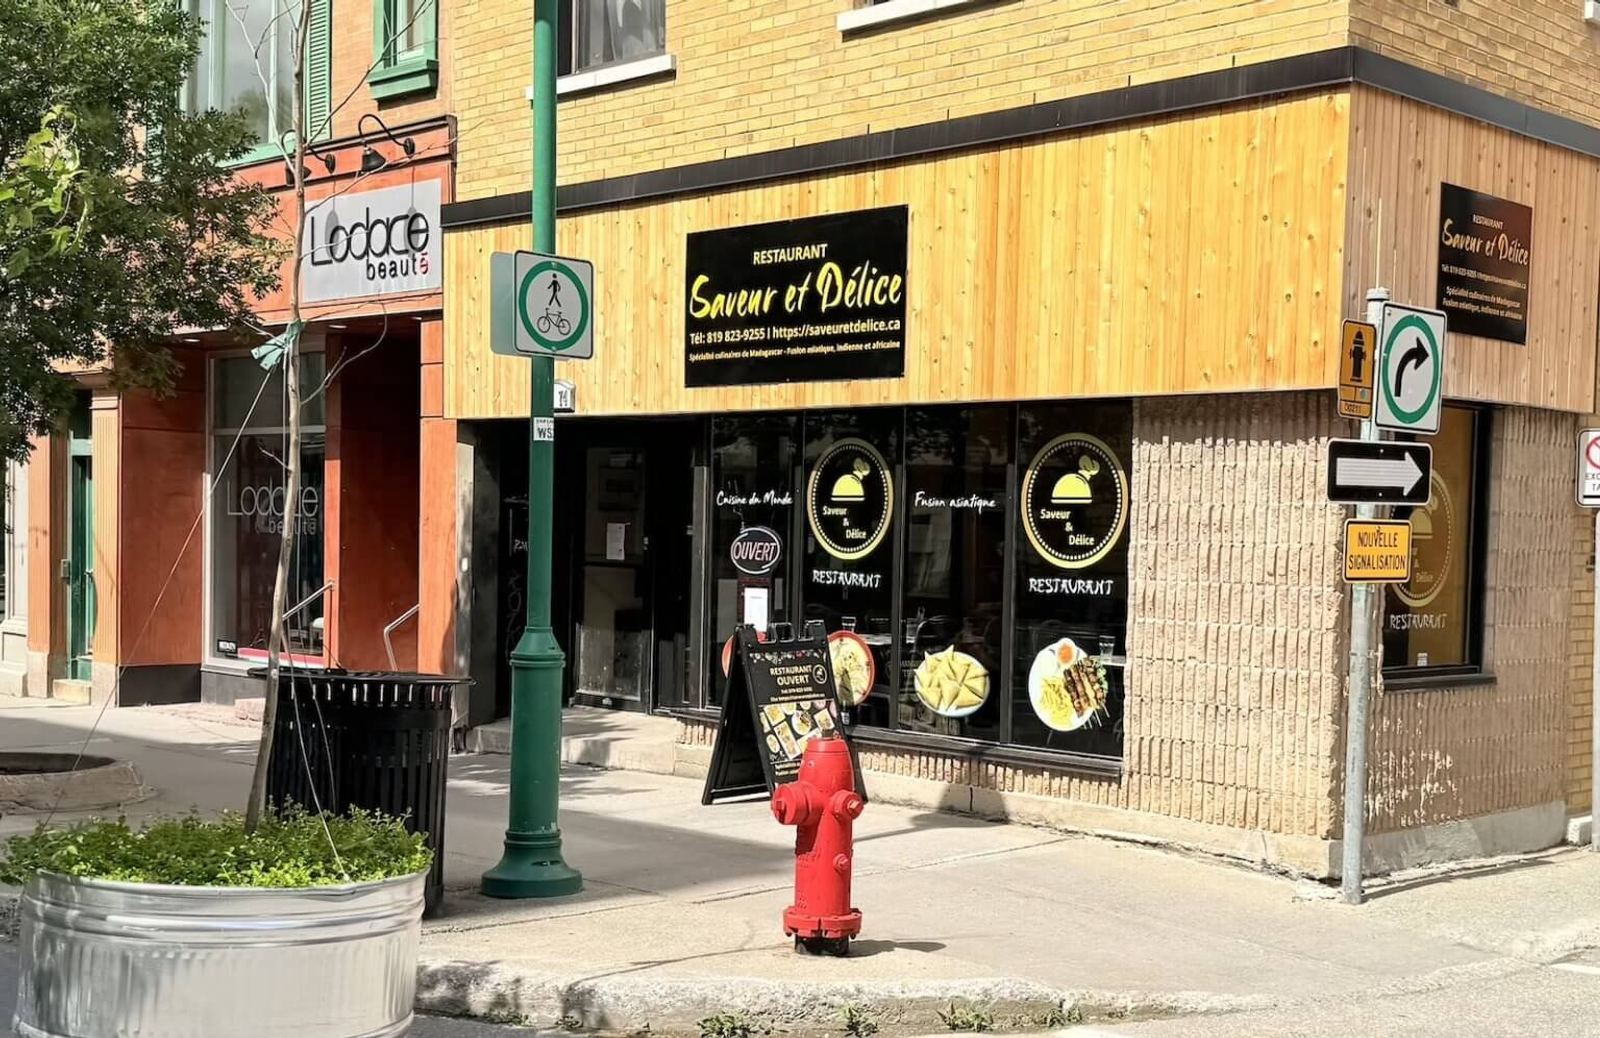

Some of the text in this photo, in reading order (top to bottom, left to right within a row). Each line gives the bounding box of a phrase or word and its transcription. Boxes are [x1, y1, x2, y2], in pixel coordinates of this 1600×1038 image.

[1442, 218, 1529, 266] Saveur et Délice
[753, 243, 828, 265] RESTAURANT
[366, 252, 429, 280] beauté
[690, 260, 902, 319] Saveur et Délice
[689, 332, 706, 345] Tél:
[706, 331, 723, 344] 819
[724, 328, 765, 342] 823-9255
[772, 318, 901, 341] https://saveuretdelice.ca
[716, 489, 793, 506] Cuisine du Monde
[914, 490, 996, 514] Fusion asiatique
[822, 506, 848, 516] Saveur
[1040, 508, 1072, 519] Saveur
[843, 518, 850, 527] &
[1065, 522, 1073, 532] &
[845, 528, 867, 539] Délice
[1068, 534, 1095, 546] Délice
[1358, 531, 1398, 547] NOUVELLE
[734, 541, 777, 561] OUVERT
[1348, 554, 1406, 570] SIGNALISATION
[812, 569, 882, 588] RESTAURANT
[1028, 577, 1114, 595] RESTAURANT
[1390, 613, 1447, 629] RESTAURANT
[770, 664, 813, 676] RESTAURANT
[777, 675, 809, 686] OUVERT
